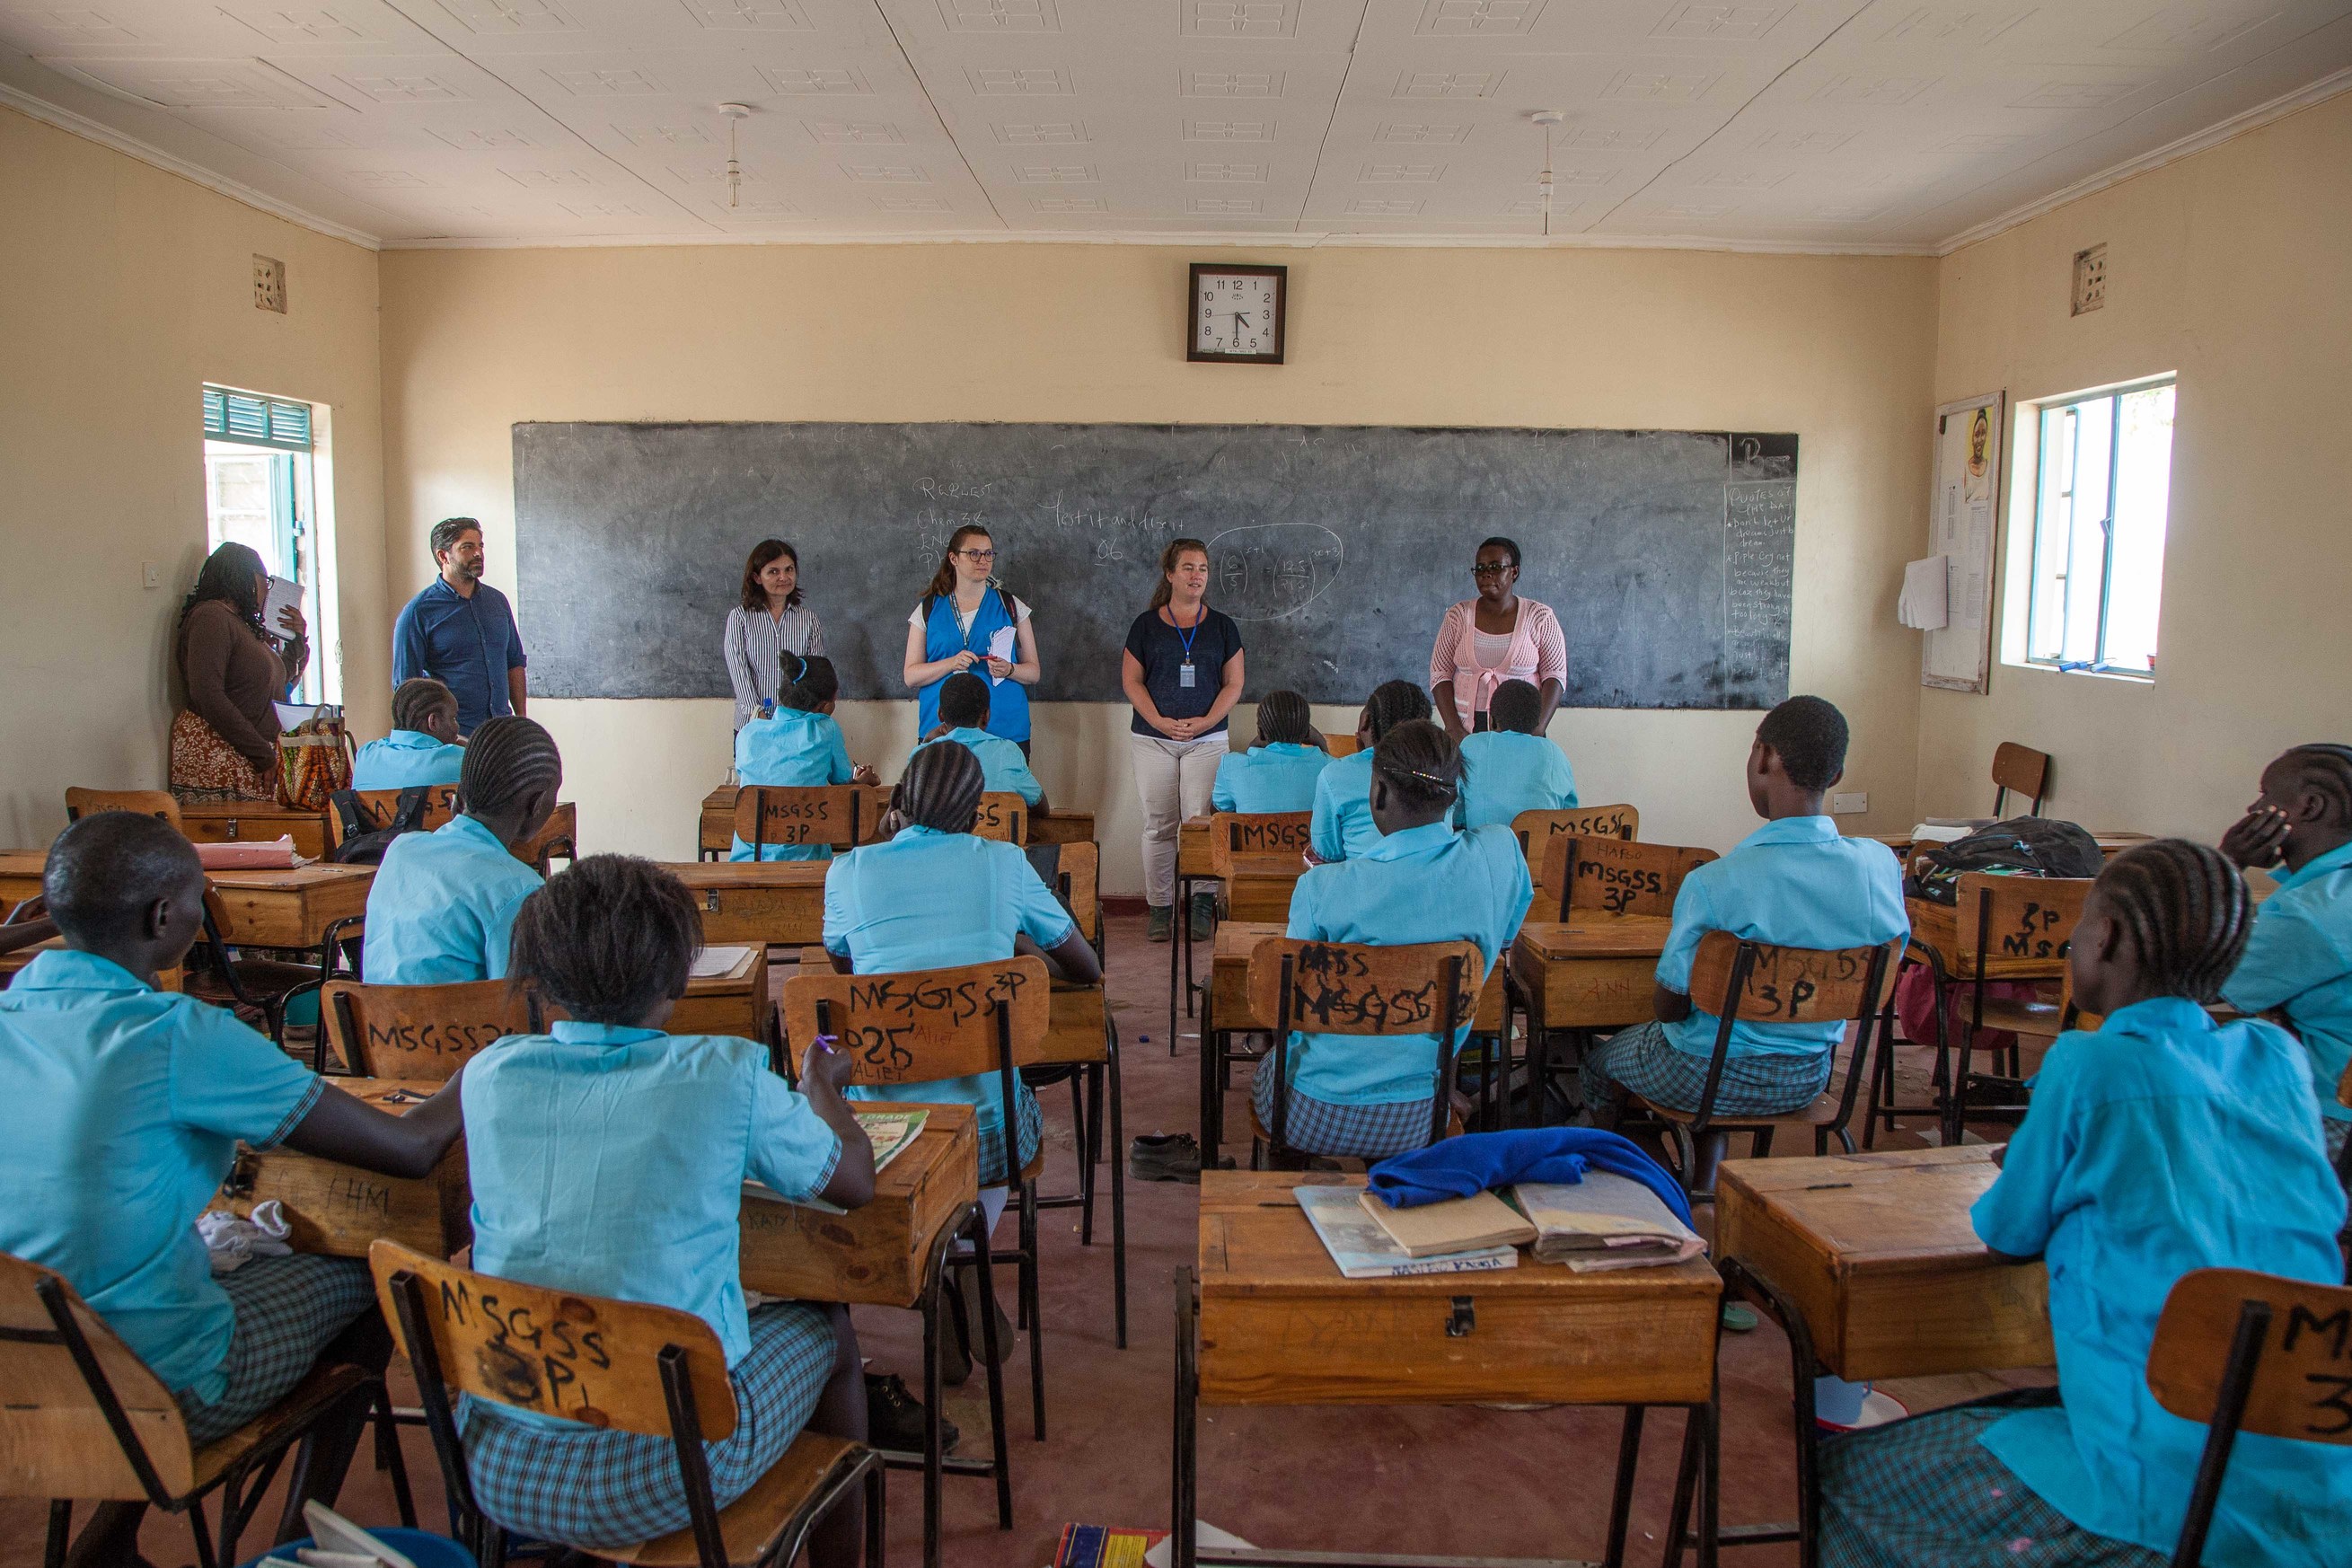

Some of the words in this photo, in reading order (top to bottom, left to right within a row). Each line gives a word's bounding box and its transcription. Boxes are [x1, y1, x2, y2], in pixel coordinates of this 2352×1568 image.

[1217, 280, 1225, 290] 11
[1232, 280, 1243, 290] 12
[1254, 281, 1257, 290] 1
[1204, 292, 1213, 301] 10
[1264, 293, 1271, 304] 2
[1205, 309, 1211, 318] 9
[1263, 310, 1270, 320] 3
[1204, 326, 1211, 336] 8
[1263, 328, 1269, 337] 4
[1216, 338, 1223, 347] 7
[1232, 338, 1239, 348] 6
[1250, 339, 1256, 348] 5
[1111, 506, 1136, 529] and
[1776, 552, 1791, 561] not
[1734, 567, 1769, 577] because
[1775, 577, 1790, 586] but
[1756, 588, 1771, 601] they
[1774, 589, 1792, 599] have
[1731, 610, 1748, 620] too
[1749, 610, 1768, 625] long
[764, 801, 828, 821] MSGSS
[786, 824, 810, 842] 3P
[1578, 859, 1661, 895] MSGSS
[1602, 887, 1637, 913] 3P
[992, 972, 1028, 1000] 3P
[1757, 980, 1816, 1018] 3P
[440, 1279, 612, 1370] MSGSS
